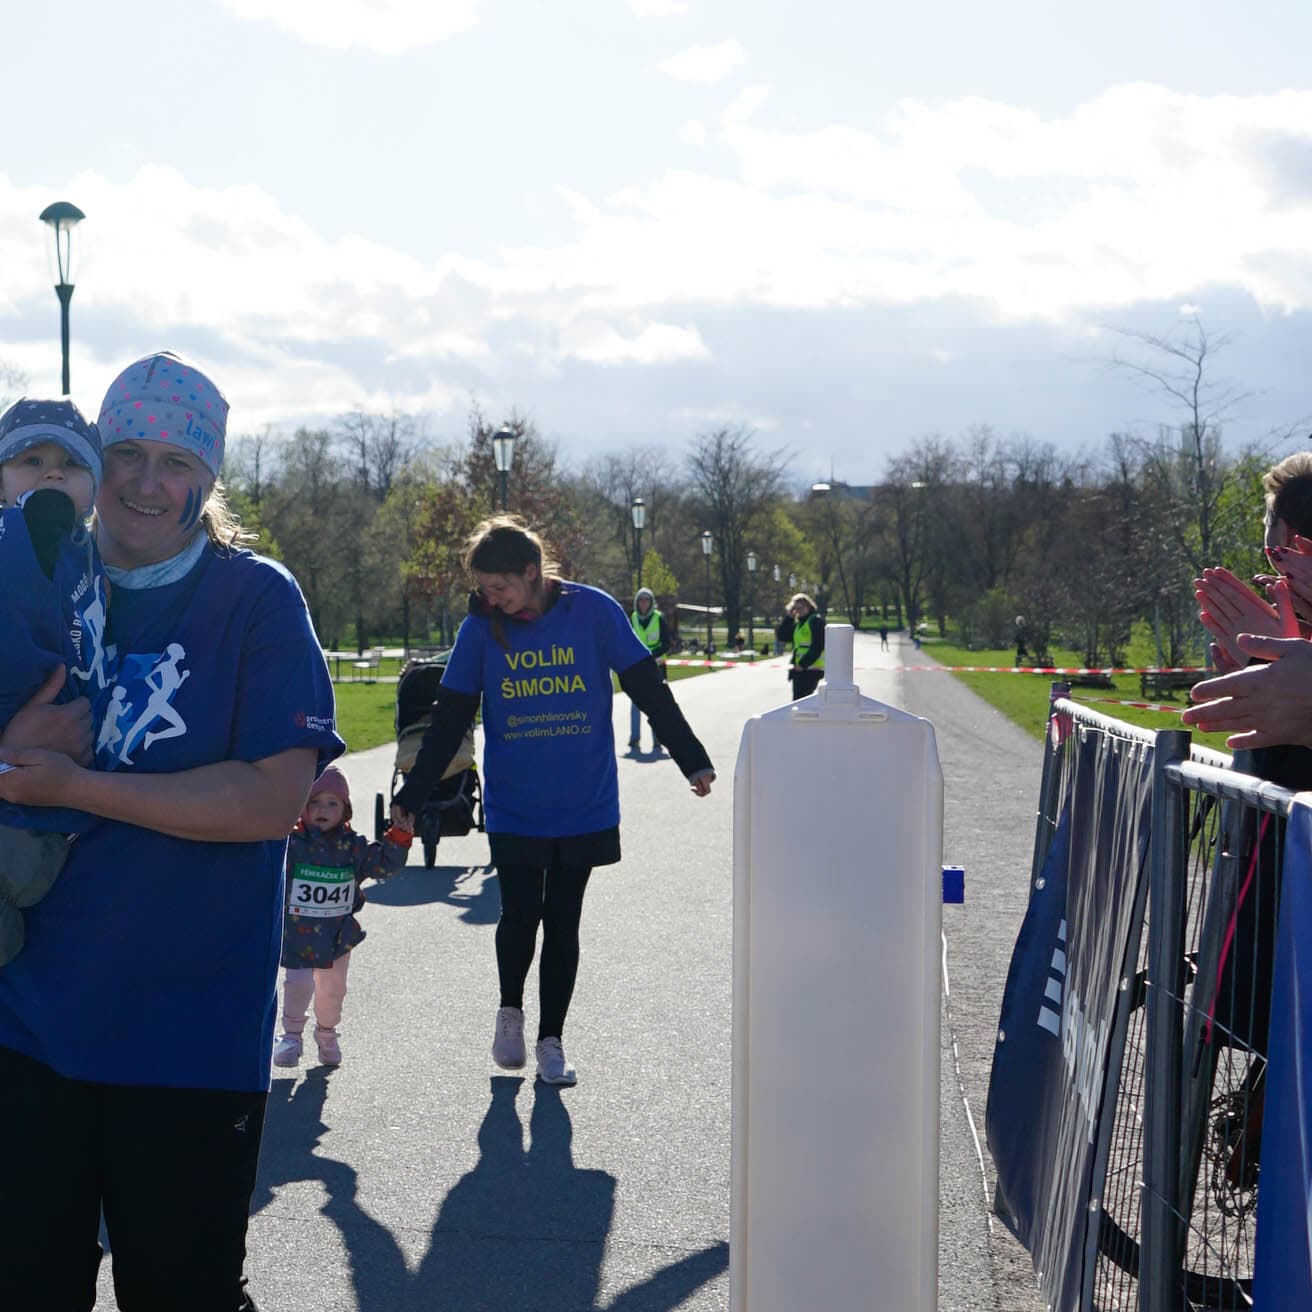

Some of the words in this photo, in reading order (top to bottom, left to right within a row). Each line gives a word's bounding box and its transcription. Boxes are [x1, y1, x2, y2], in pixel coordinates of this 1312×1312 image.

[505, 644, 575, 671] VOLÍM
[501, 674, 586, 699] ŠIMONA
[297, 884, 350, 904] 3041
